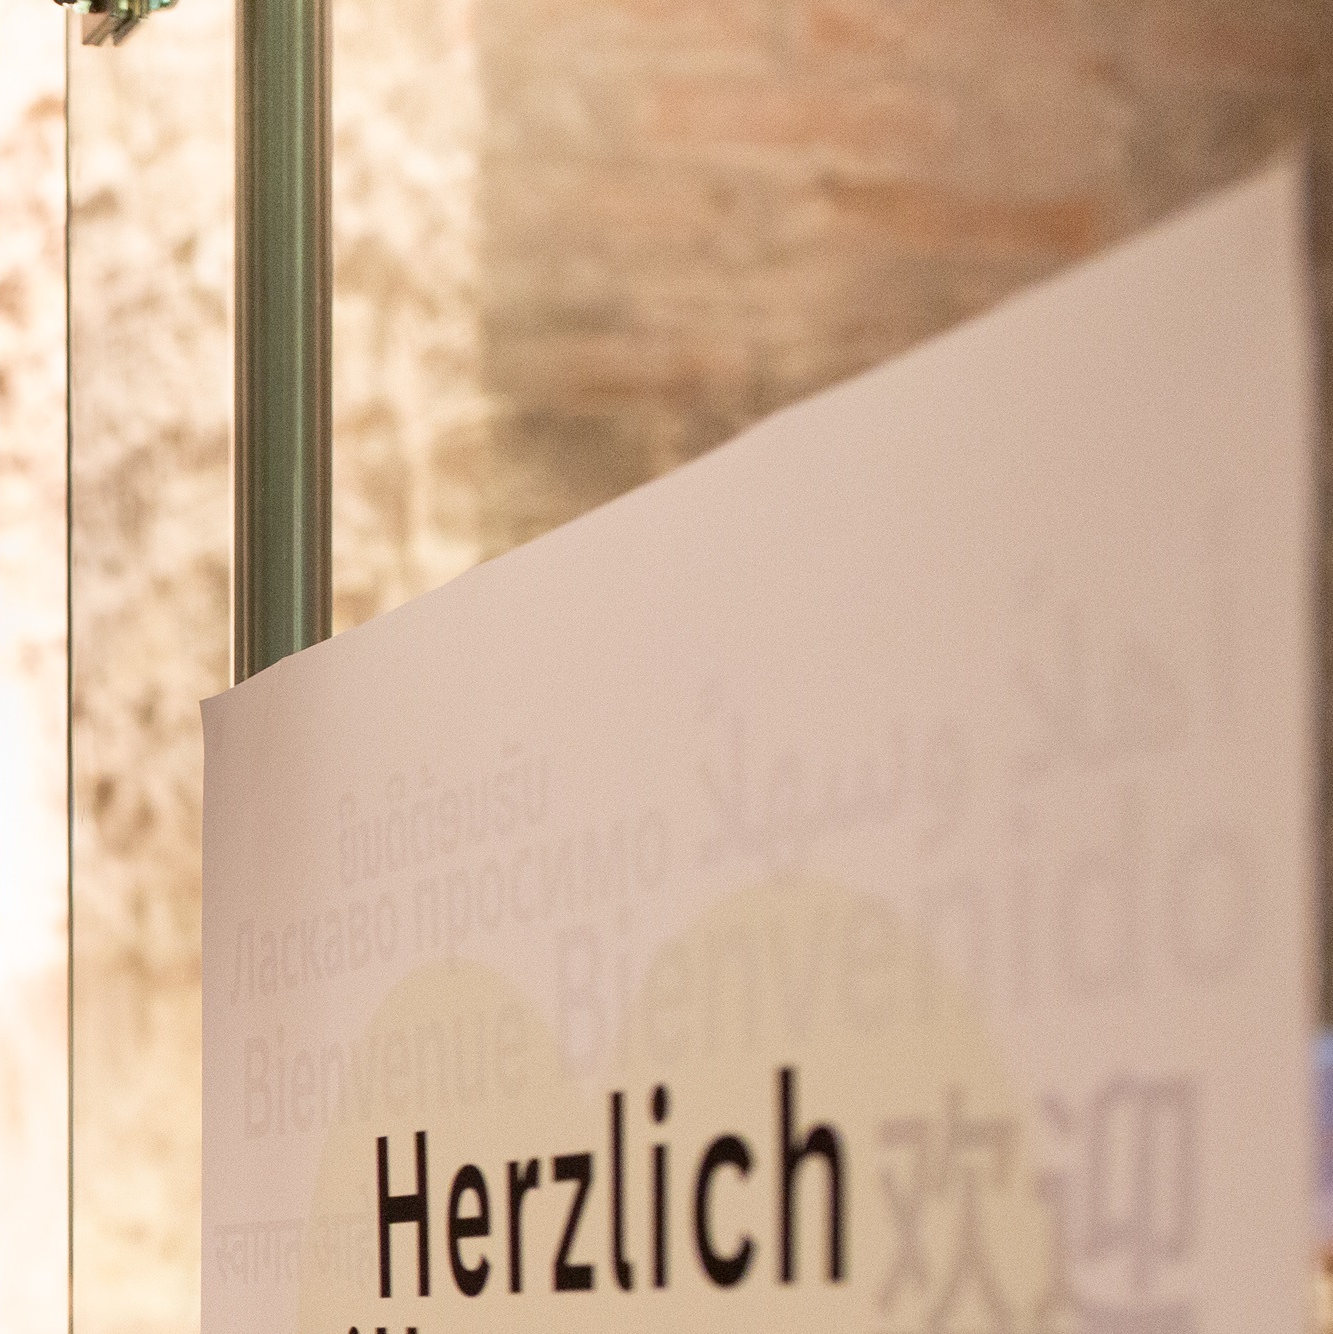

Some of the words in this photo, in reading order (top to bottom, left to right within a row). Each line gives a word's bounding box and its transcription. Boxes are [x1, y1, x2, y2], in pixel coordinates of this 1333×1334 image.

[228, 892, 400, 1005] Ласкаво
[413, 808, 669, 977] просимо
[554, 780, 1256, 1082] Bienvenido
[242, 1002, 531, 1141] Bienvenue
[376, 1066, 846, 1299] Herzlich
